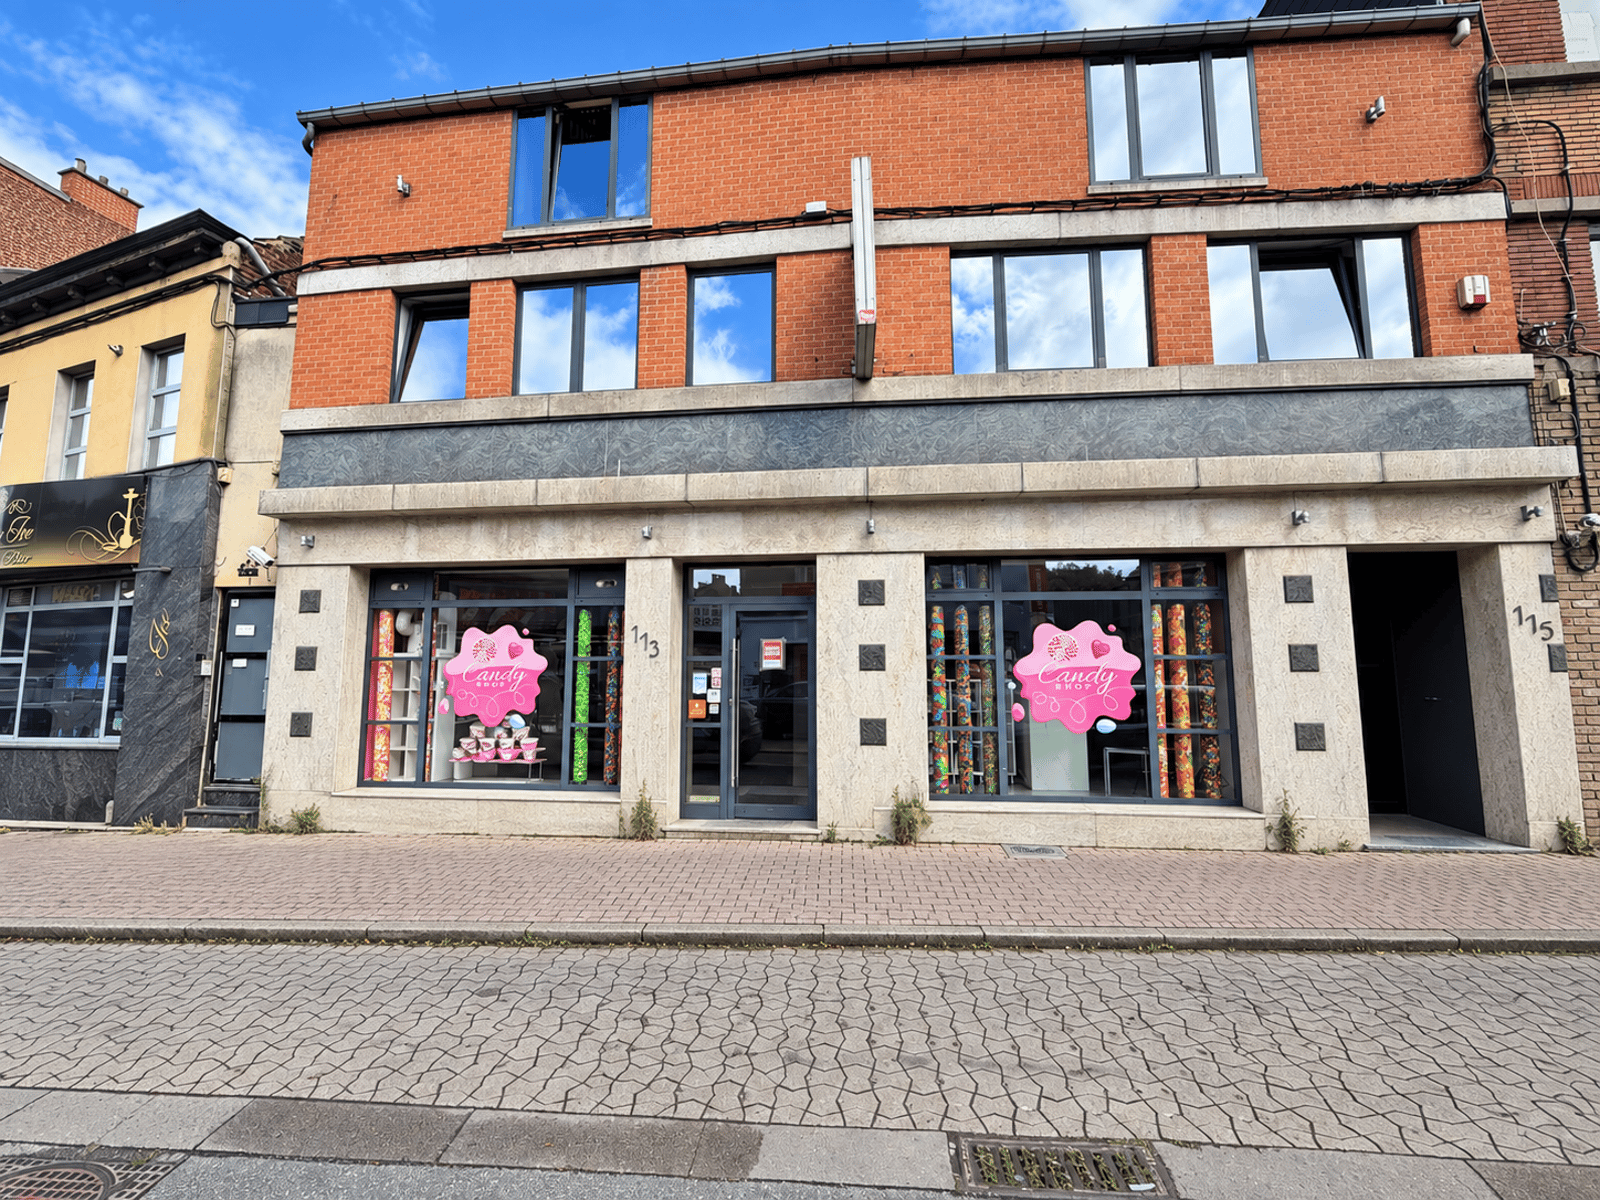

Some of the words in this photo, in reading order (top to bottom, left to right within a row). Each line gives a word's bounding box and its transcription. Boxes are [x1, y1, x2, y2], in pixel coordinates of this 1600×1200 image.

[1512, 605, 1554, 642] 115
[630, 624, 660, 658] 113
[462, 661, 528, 692] Candy
[1038, 661, 1118, 695] Candy
